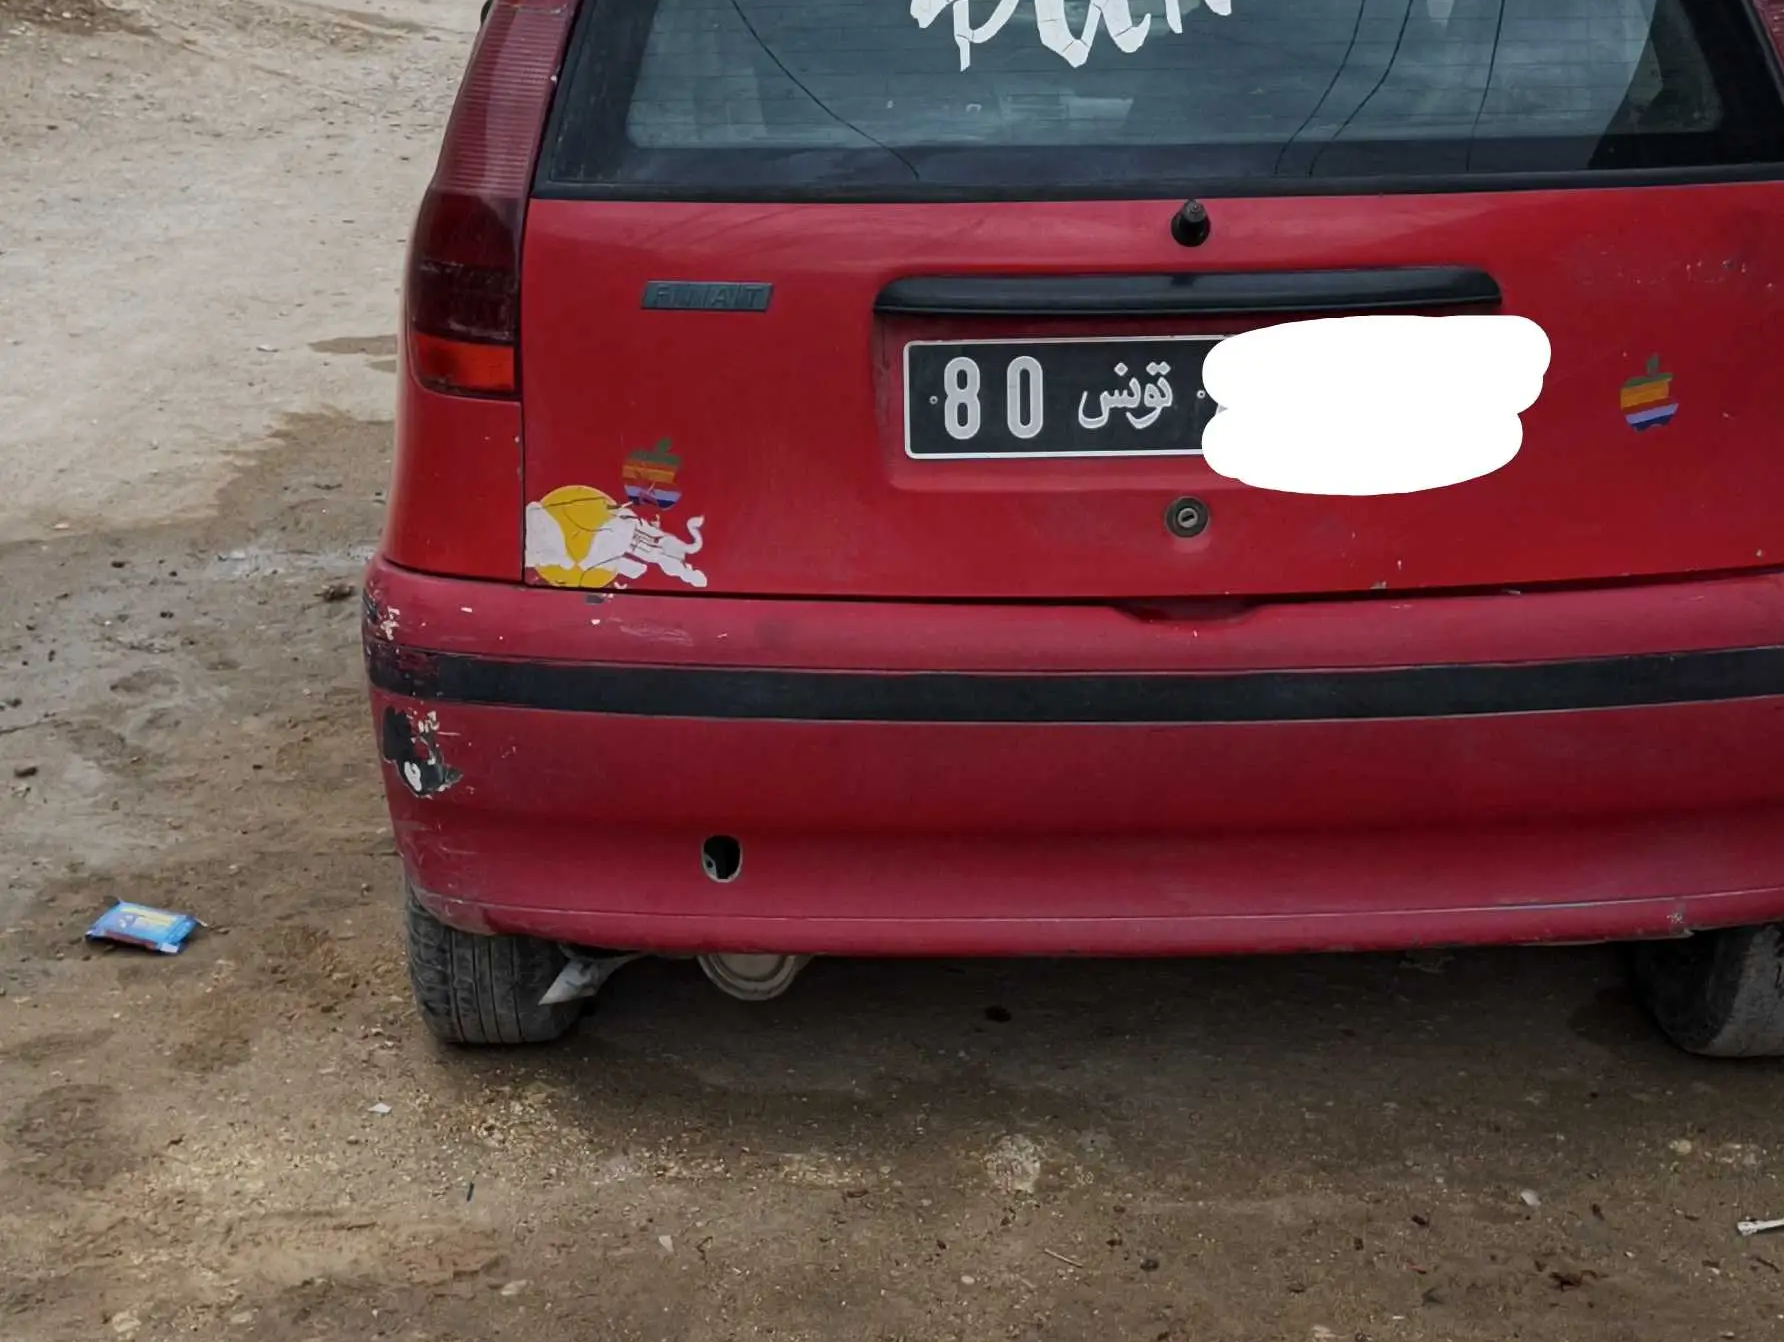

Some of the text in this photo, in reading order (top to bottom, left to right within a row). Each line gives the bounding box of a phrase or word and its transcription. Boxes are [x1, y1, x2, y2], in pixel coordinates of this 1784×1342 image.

[649, 284, 766, 309] FIAT
[943, 355, 1174, 440] 80 تونس
